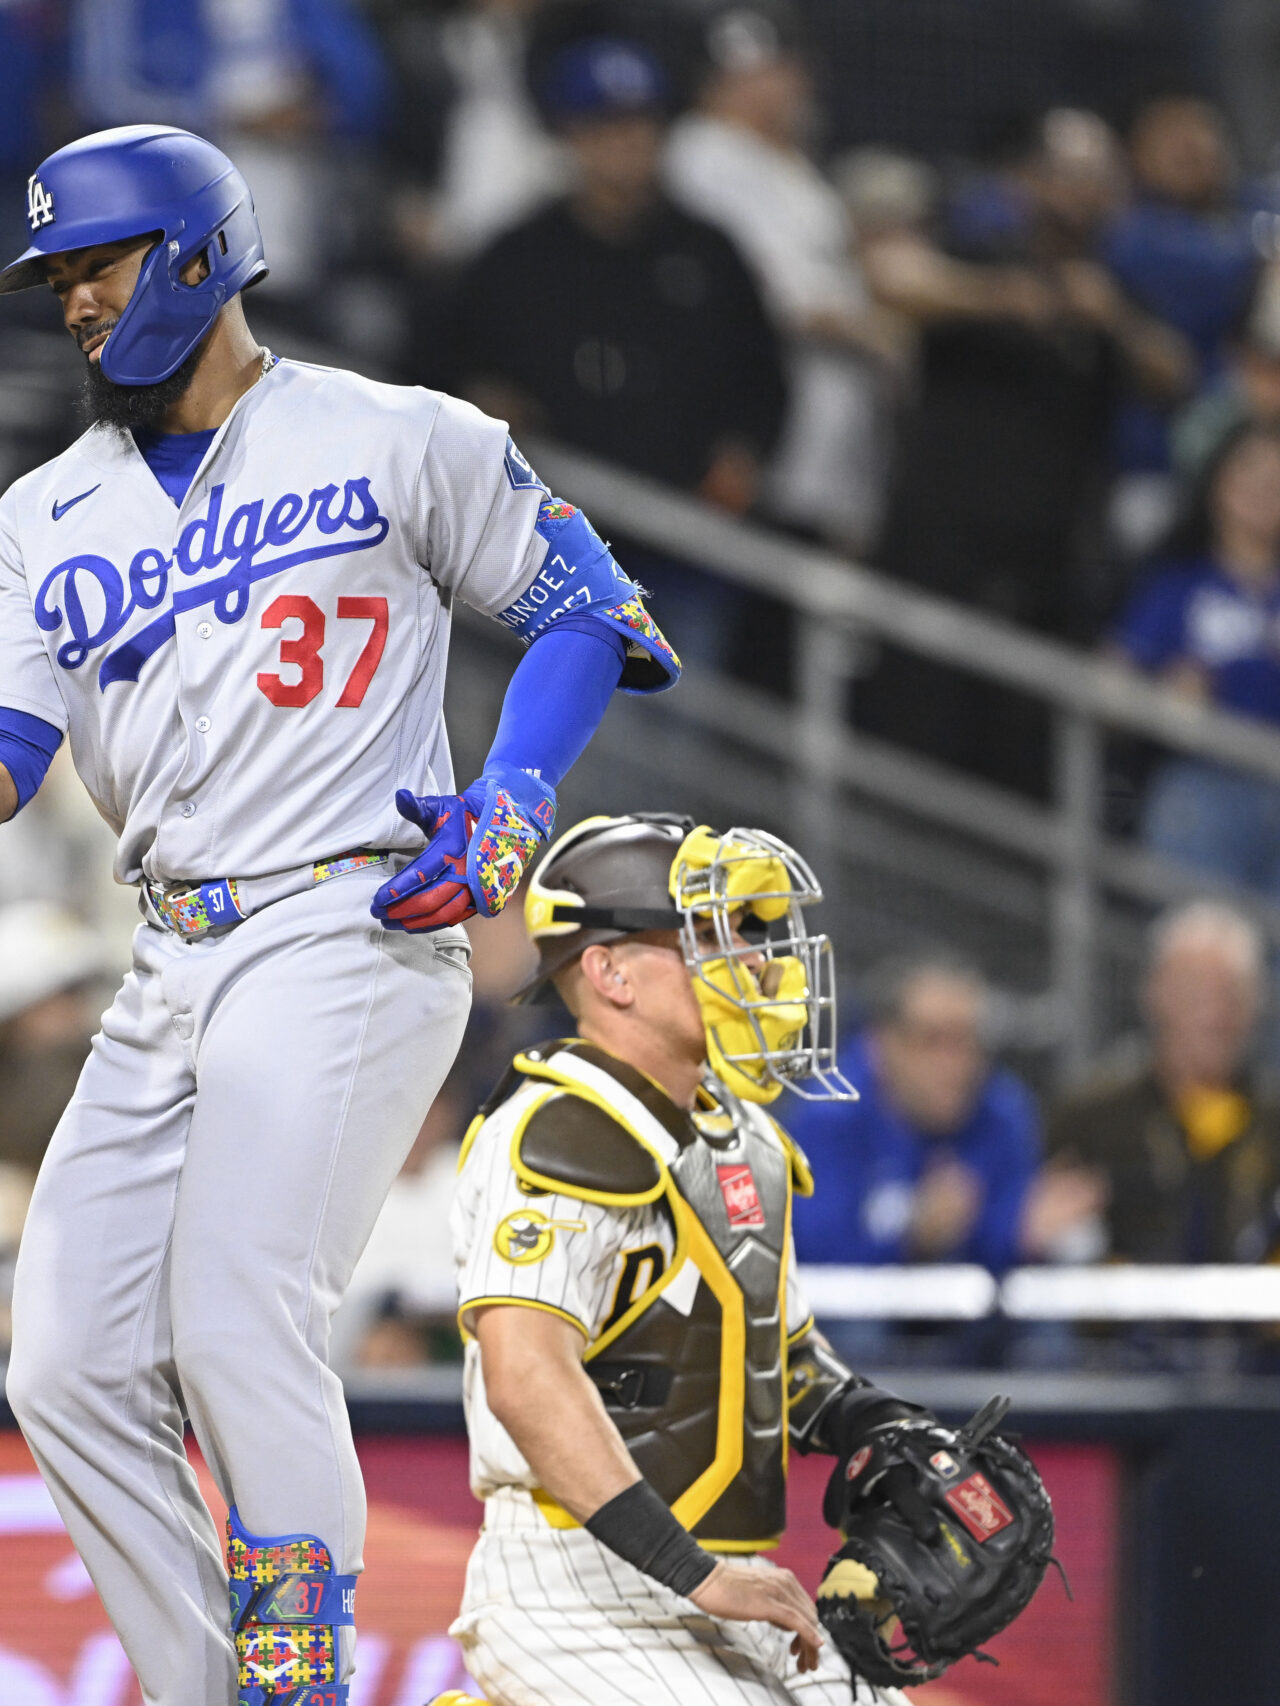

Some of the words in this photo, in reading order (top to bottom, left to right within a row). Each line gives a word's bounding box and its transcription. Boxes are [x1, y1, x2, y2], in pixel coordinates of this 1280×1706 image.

[35, 475, 389, 671] Dodgers
[256, 594, 390, 709] 37
[207, 887, 225, 914] 37
[295, 1582, 324, 1614] 37
